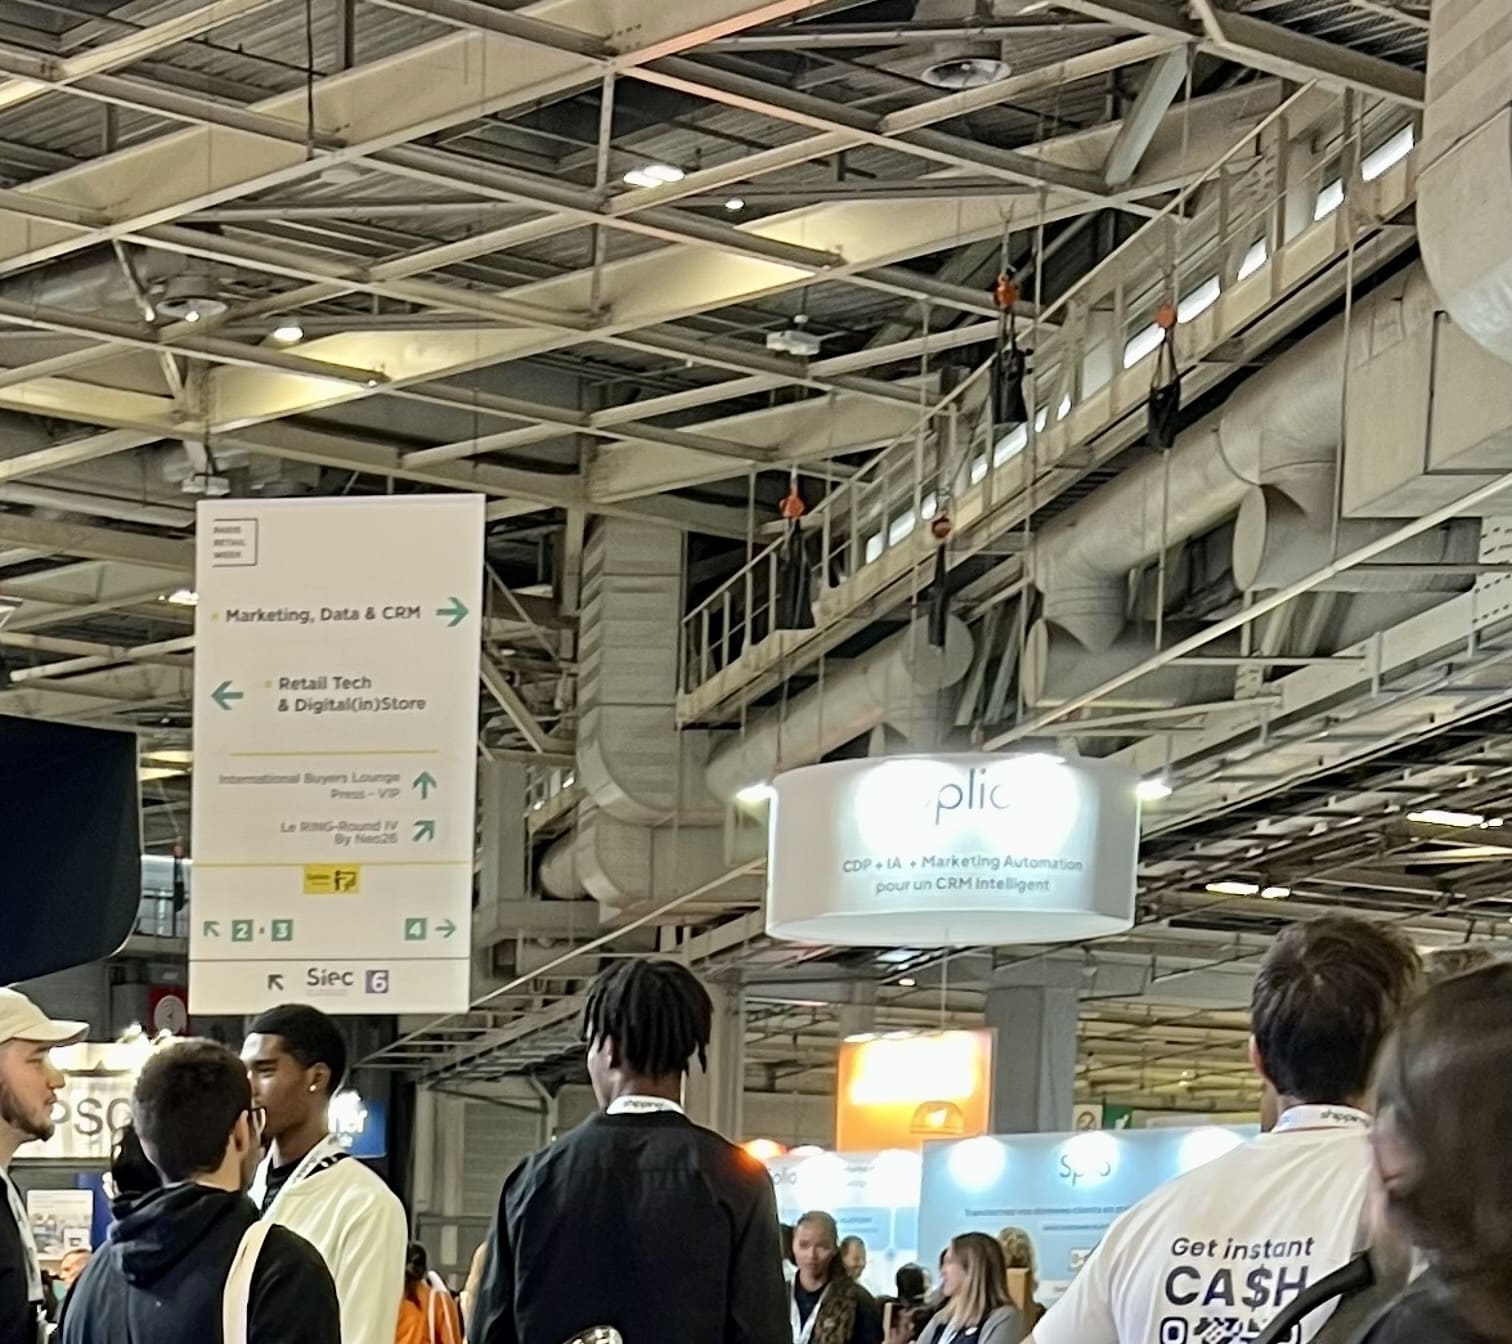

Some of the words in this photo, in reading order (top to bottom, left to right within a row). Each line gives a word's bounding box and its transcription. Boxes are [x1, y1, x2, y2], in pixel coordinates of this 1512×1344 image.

[226, 608, 315, 624] Marketing,
[321, 607, 359, 621] Data
[365, 607, 376, 620] &
[382, 605, 421, 620] CRM
[279, 676, 327, 690] Retail
[333, 676, 371, 690] Tech
[278, 699, 289, 713] &
[295, 697, 426, 714] Digital(in)Store
[843, 859, 872, 873] CDP
[922, 855, 1001, 872] Marketing
[1003, 856, 1083, 872] Automation
[876, 880, 910, 896] pour
[913, 880, 932, 890] un
[936, 878, 973, 890] CRM
[976, 878, 1050, 894] Intelligent
[236, 924, 248, 938] 2
[276, 923, 289, 937] 3
[409, 922, 421, 936] 4
[307, 968, 354, 987] Siec
[370, 972, 387, 991] 6
[1171, 1237, 1218, 1257] Get
[1223, 1237, 1315, 1260] instant
